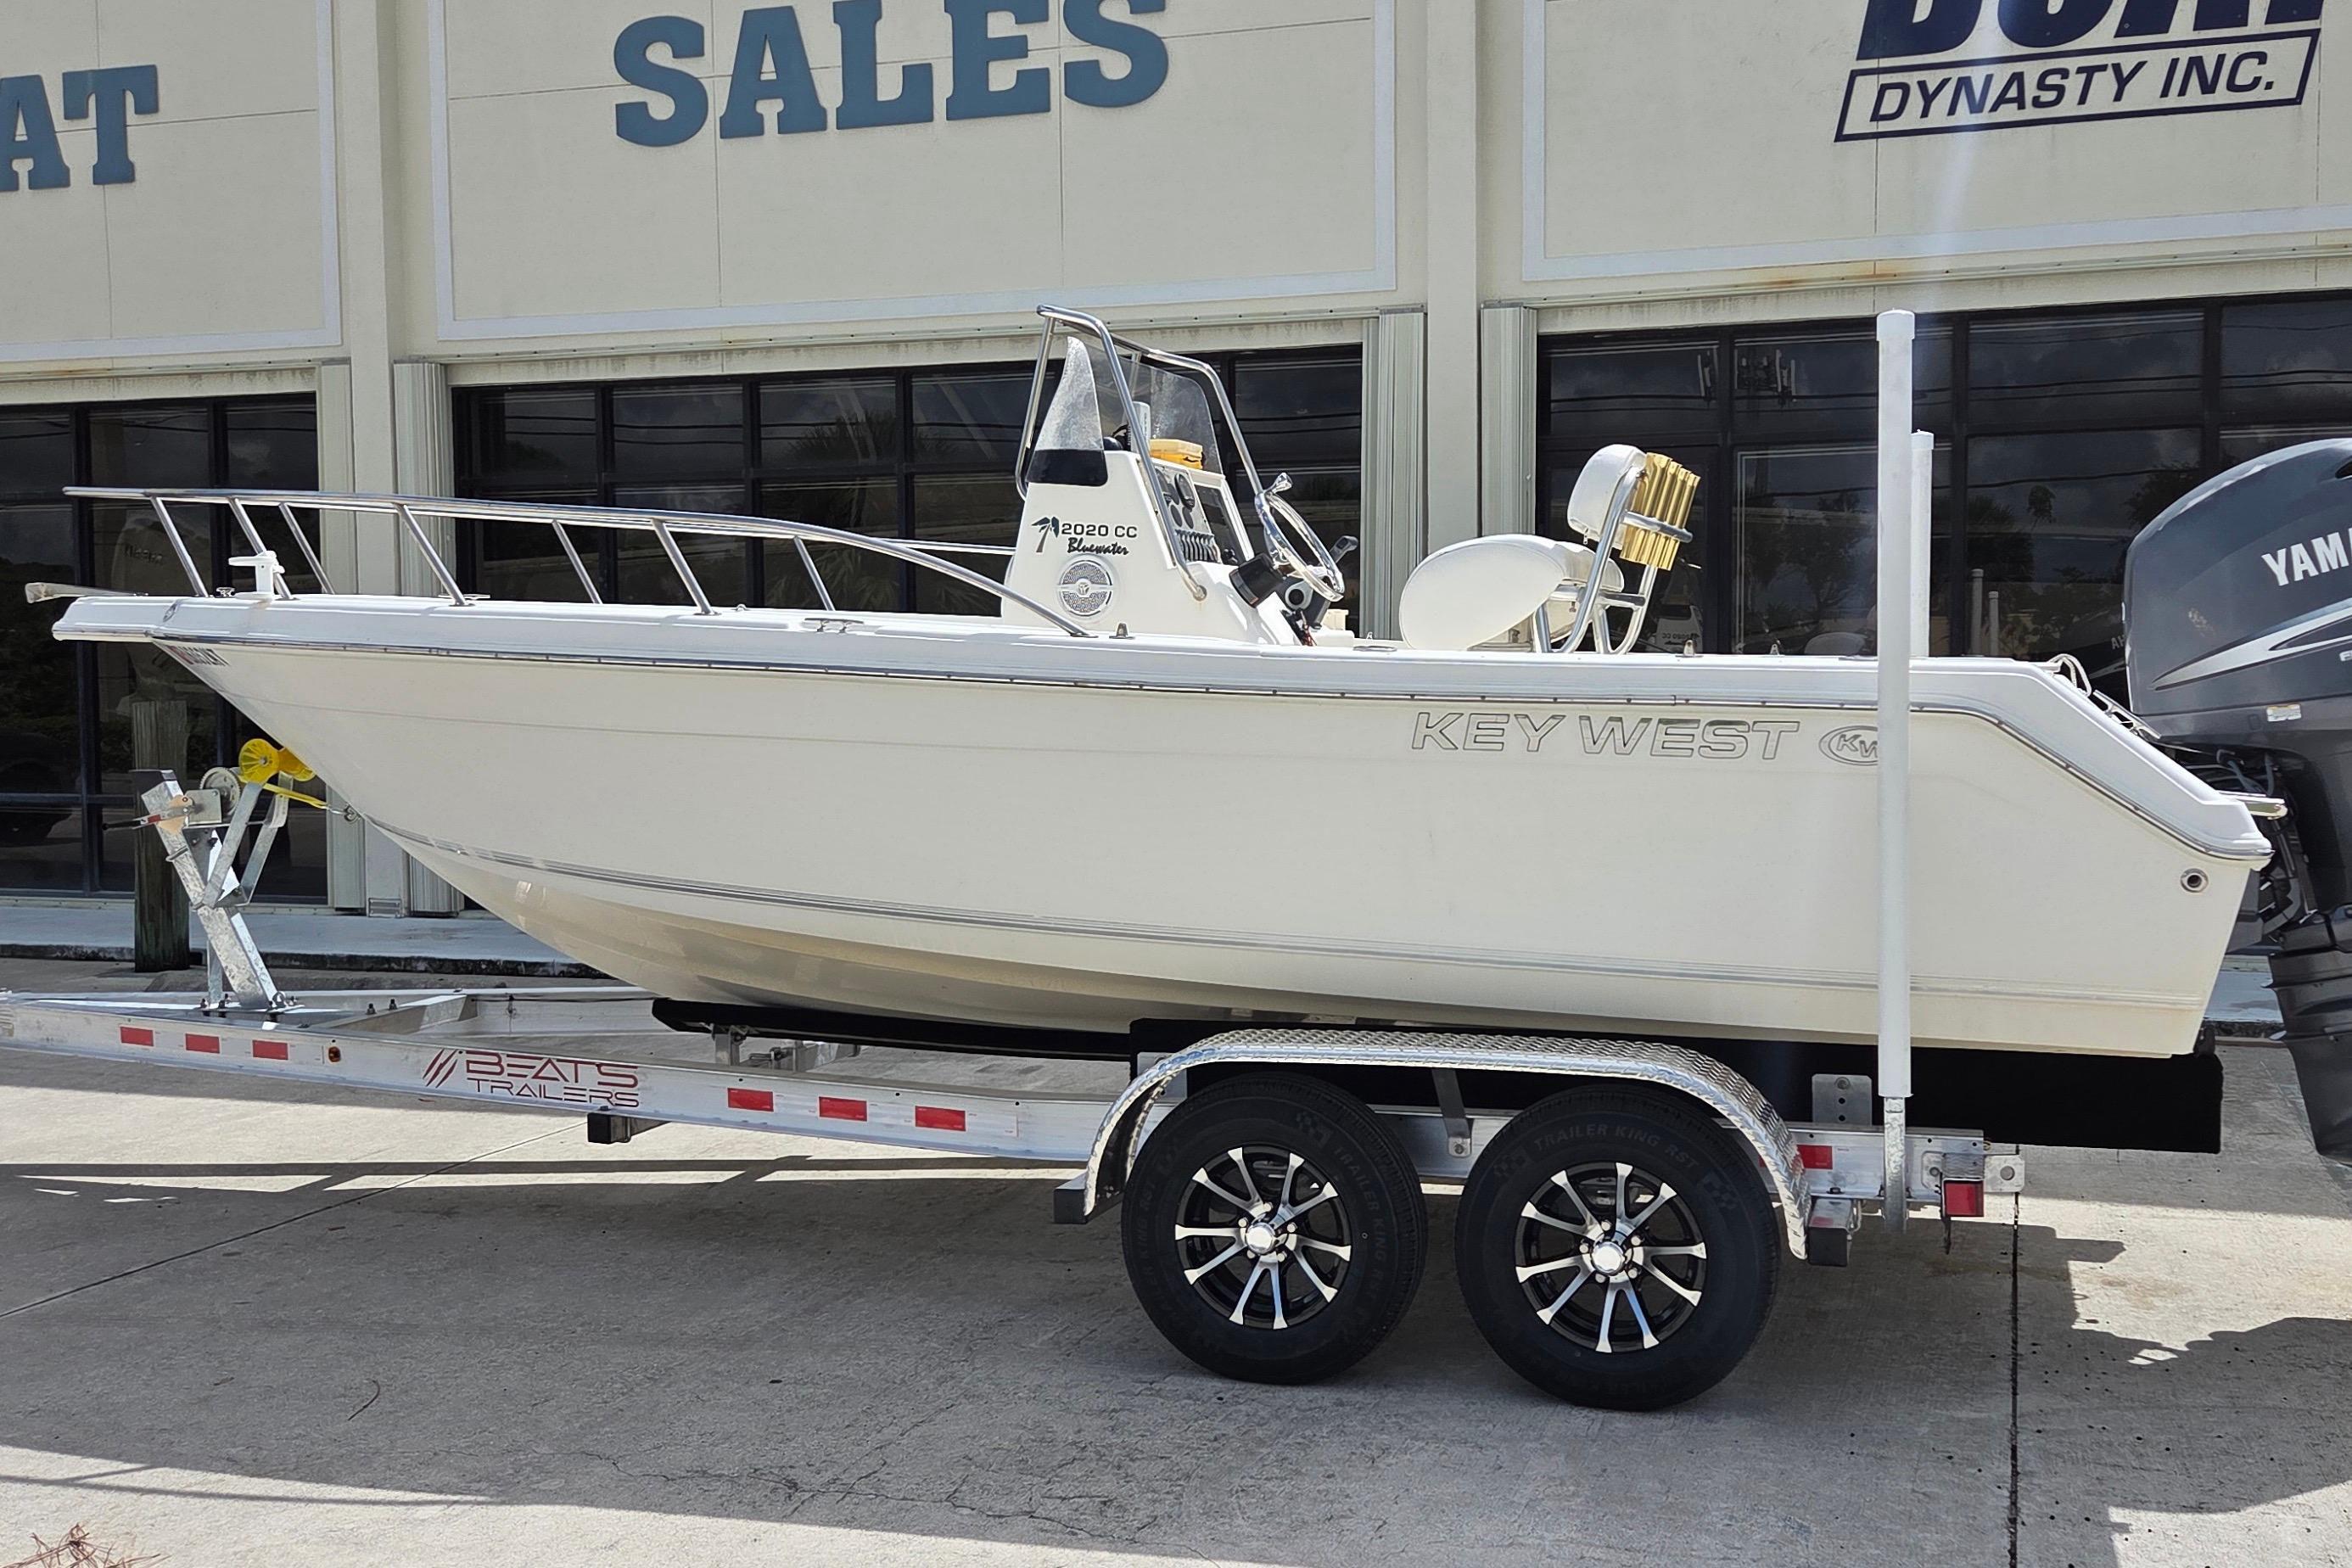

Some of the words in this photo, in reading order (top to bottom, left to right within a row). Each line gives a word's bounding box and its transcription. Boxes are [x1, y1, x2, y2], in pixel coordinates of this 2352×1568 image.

[613, 0, 1169, 147] SALES
[1869, 60, 2148, 122] DYNASTY
[2159, 51, 2276, 99] INC.
[0, 64, 160, 192] AT
[1061, 523, 1110, 537] 2020
[1114, 525, 1138, 539] CC
[1067, 536, 1129, 556] Bluewater
[2261, 527, 2352, 586] YAM
[1411, 711, 1565, 753] KEY
[1578, 714, 1800, 760] WEST
[466, 1049, 639, 1089] BEATS
[467, 1077, 640, 1108] TRAILERS
[1533, 1123, 1609, 1151] TRAILER
[1615, 1124, 1660, 1148] KING
[1664, 1143, 1699, 1169] RST
[1332, 1145, 1380, 1210] TRAILER
[1371, 1217, 1386, 1263] KING
